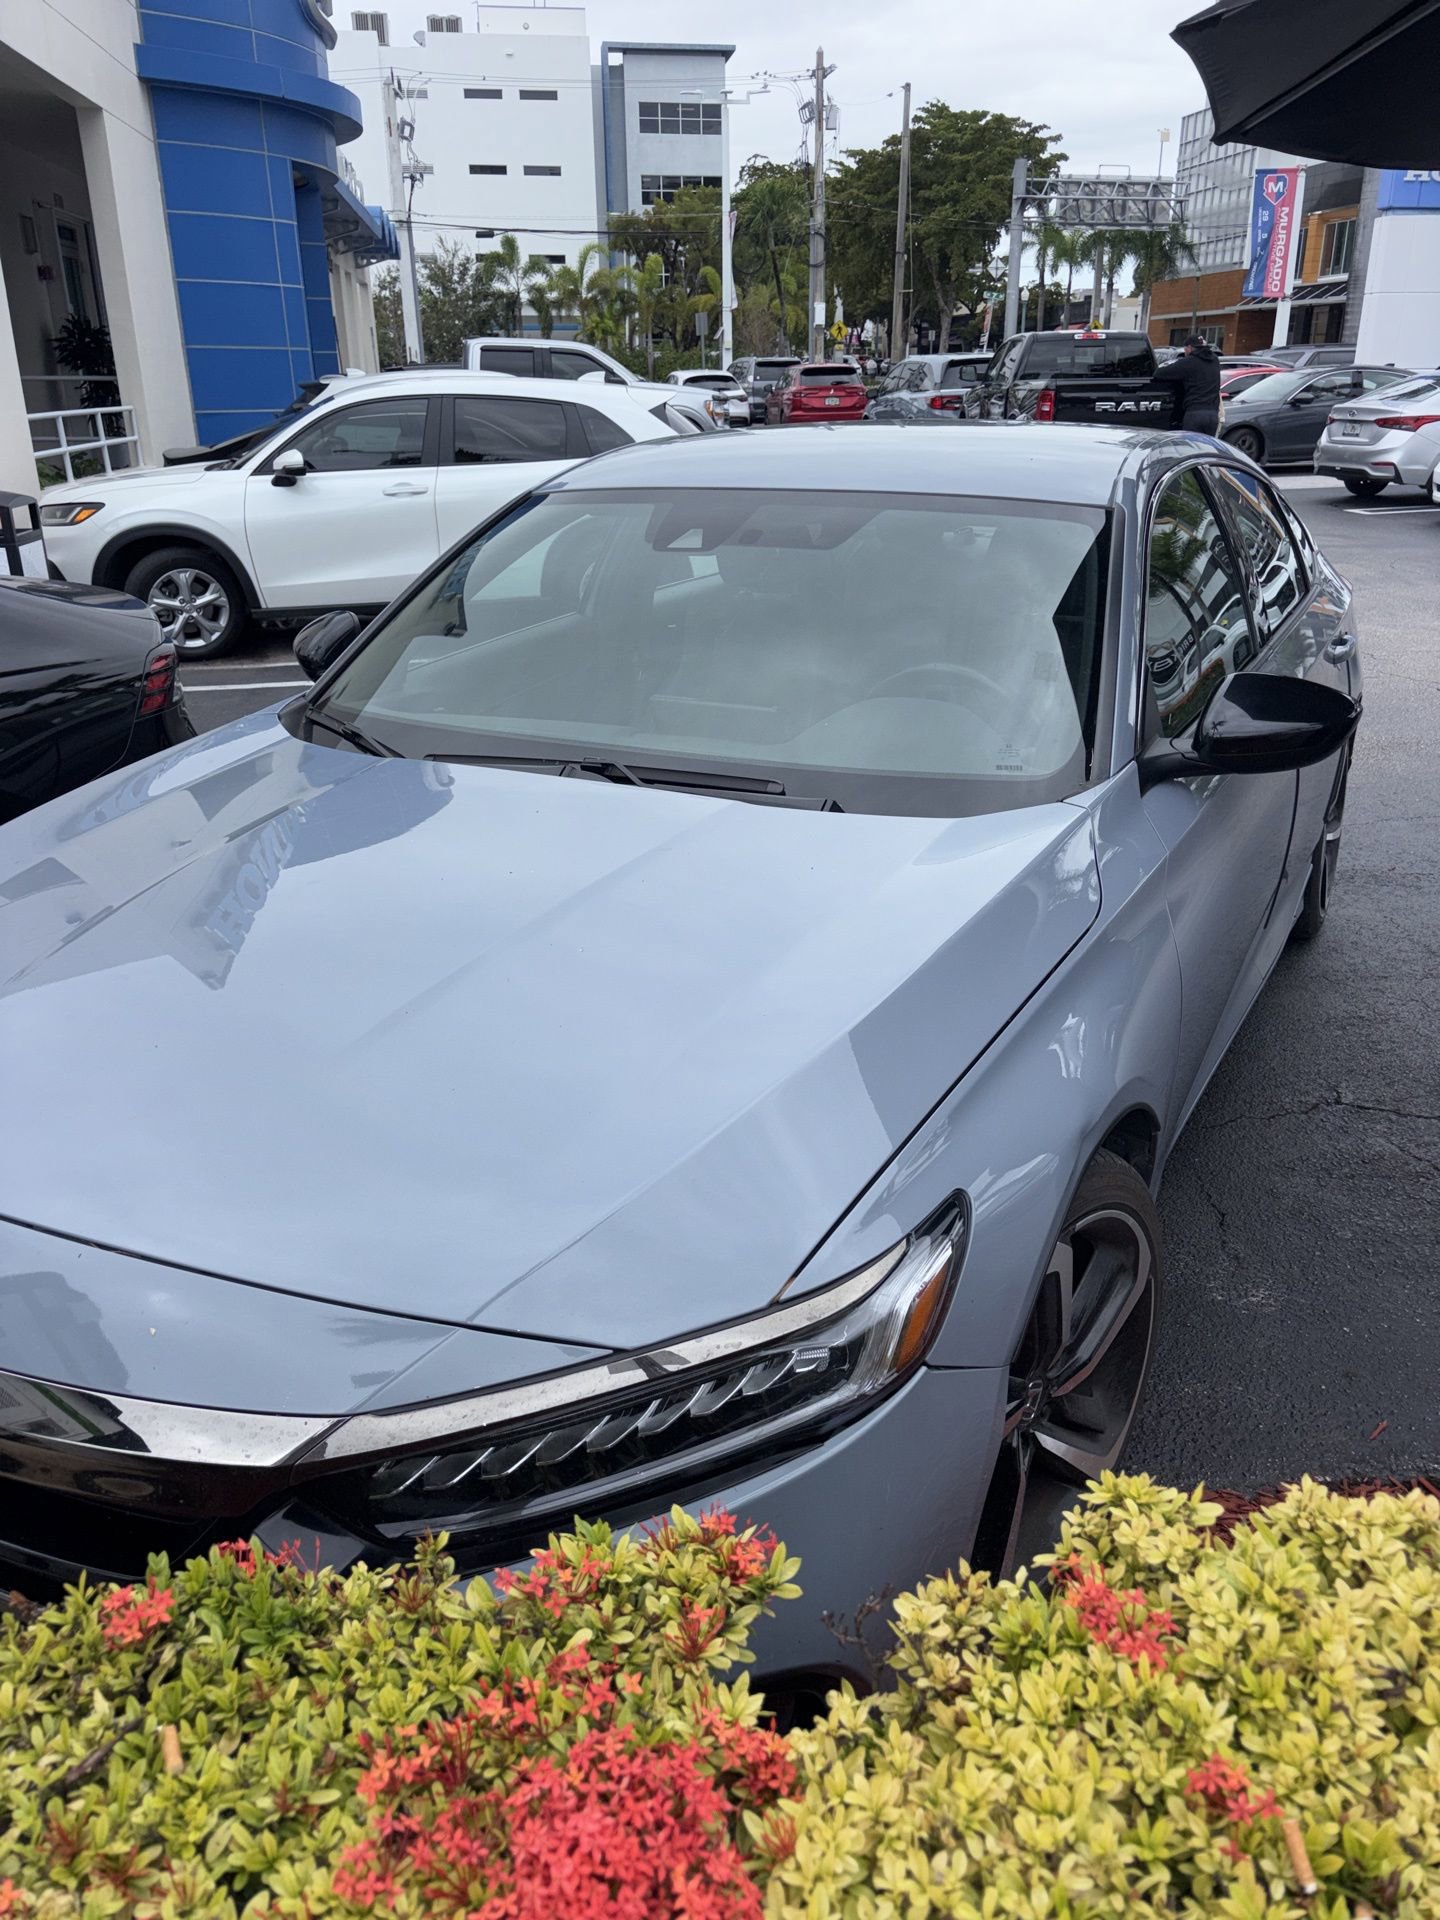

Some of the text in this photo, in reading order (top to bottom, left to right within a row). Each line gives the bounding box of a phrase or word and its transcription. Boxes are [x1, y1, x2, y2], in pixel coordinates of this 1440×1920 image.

[1268, 182, 1284, 193] M
[1271, 206, 1290, 292] MURGADO
[1095, 401, 1162, 412] RAM
